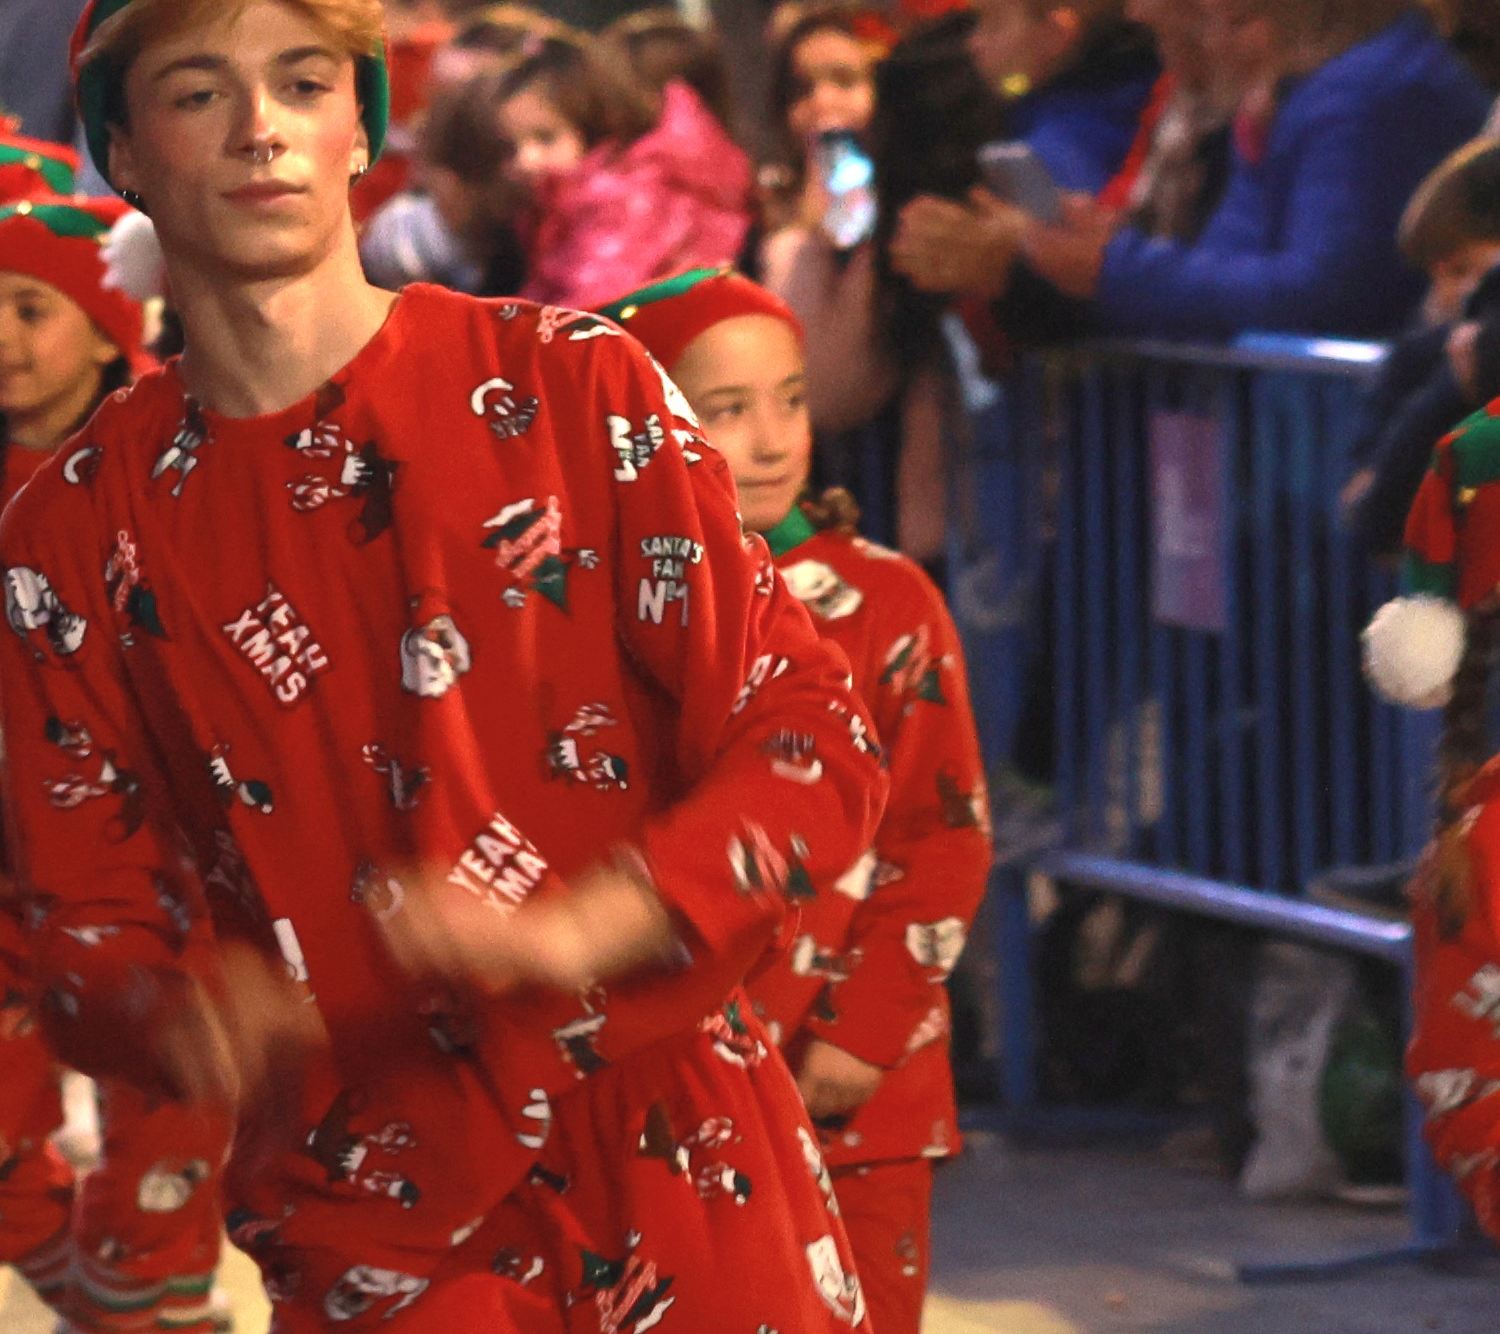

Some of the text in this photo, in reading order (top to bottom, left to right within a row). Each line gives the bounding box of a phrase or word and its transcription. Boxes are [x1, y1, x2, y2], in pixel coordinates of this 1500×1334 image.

[640, 536, 704, 564] SANTA'S
[652, 558, 684, 579] FAN
[222, 608, 307, 703] XMAS
[256, 581, 329, 676] YEAH
[446, 811, 522, 896] YEAH
[482, 838, 549, 912] XMA
